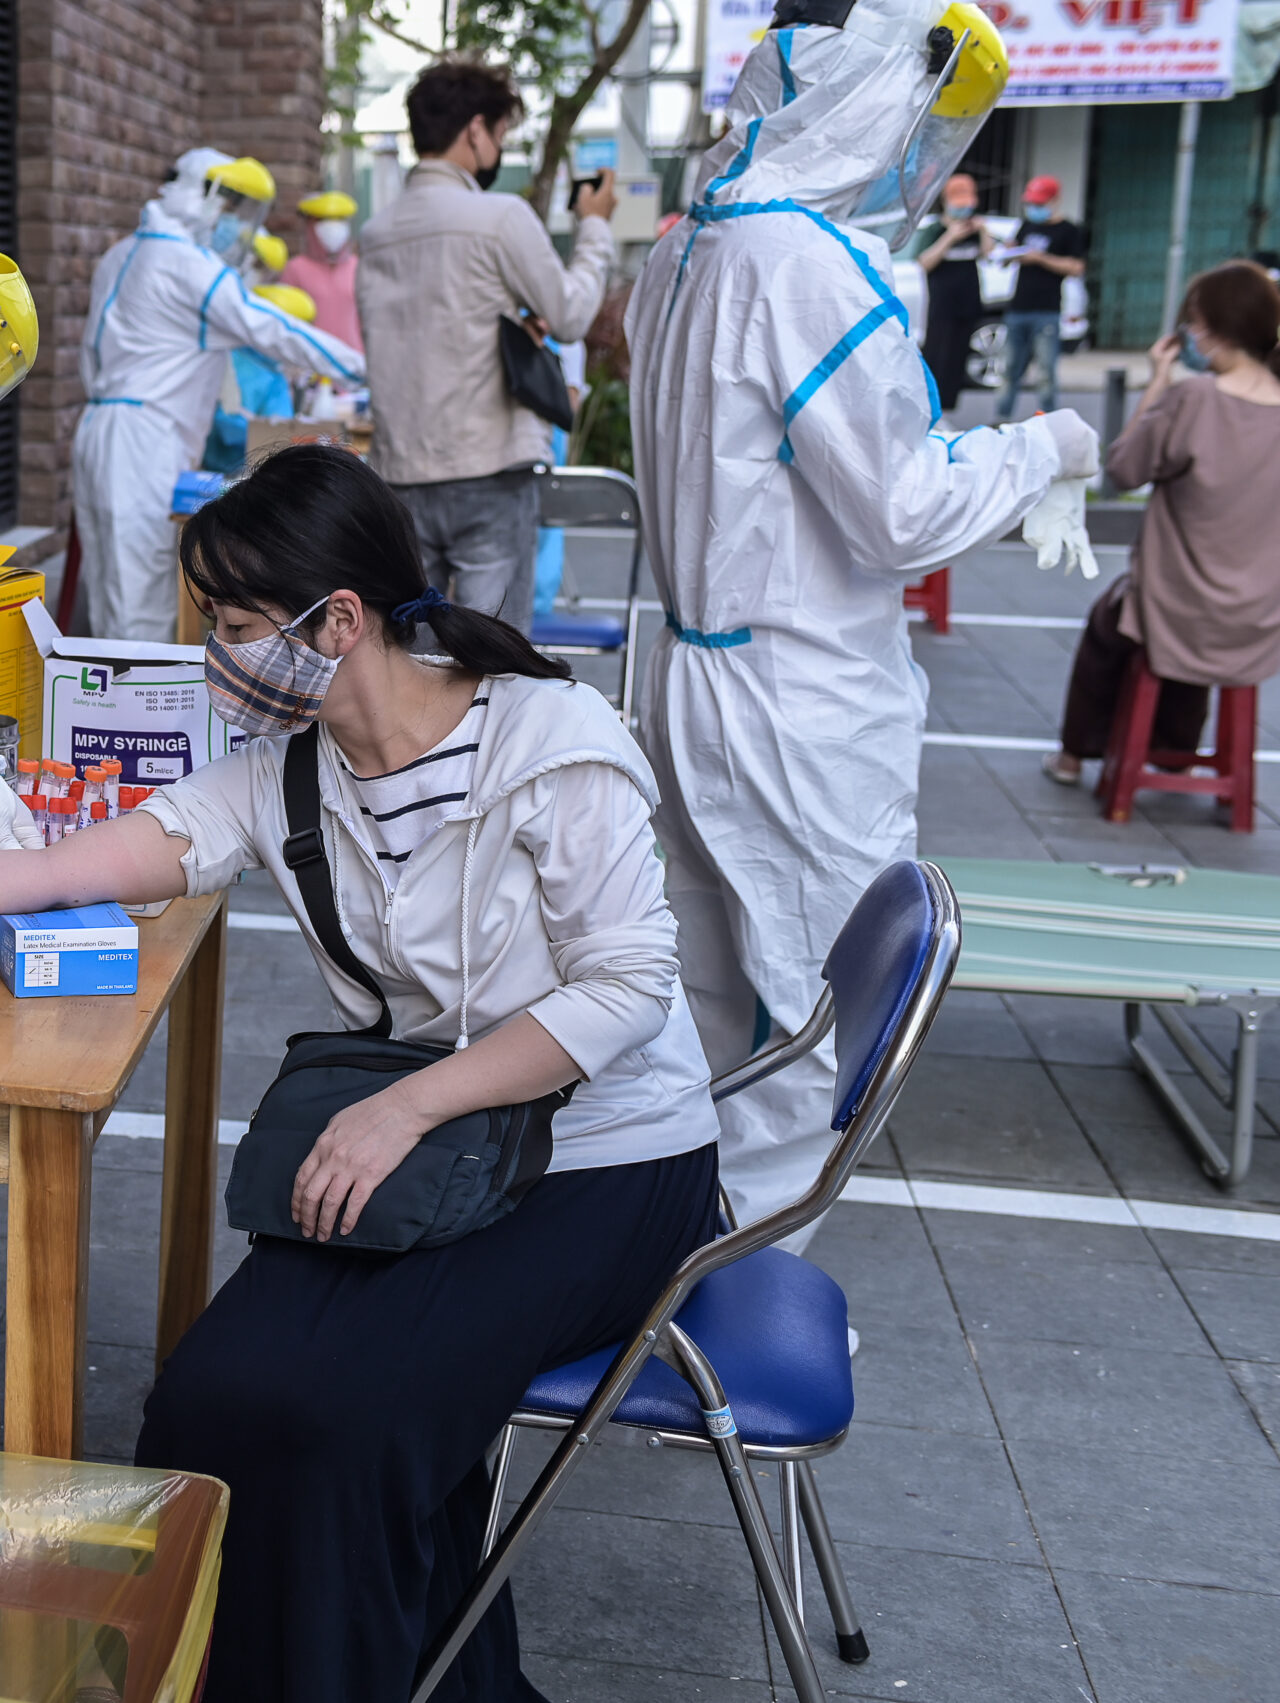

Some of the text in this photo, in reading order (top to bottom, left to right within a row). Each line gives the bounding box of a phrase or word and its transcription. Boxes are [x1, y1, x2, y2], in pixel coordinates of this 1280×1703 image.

[75, 733, 188, 752] MPV SYRINGE
[146, 763, 154, 773] 5
[98, 953, 133, 961] MEDITEX
